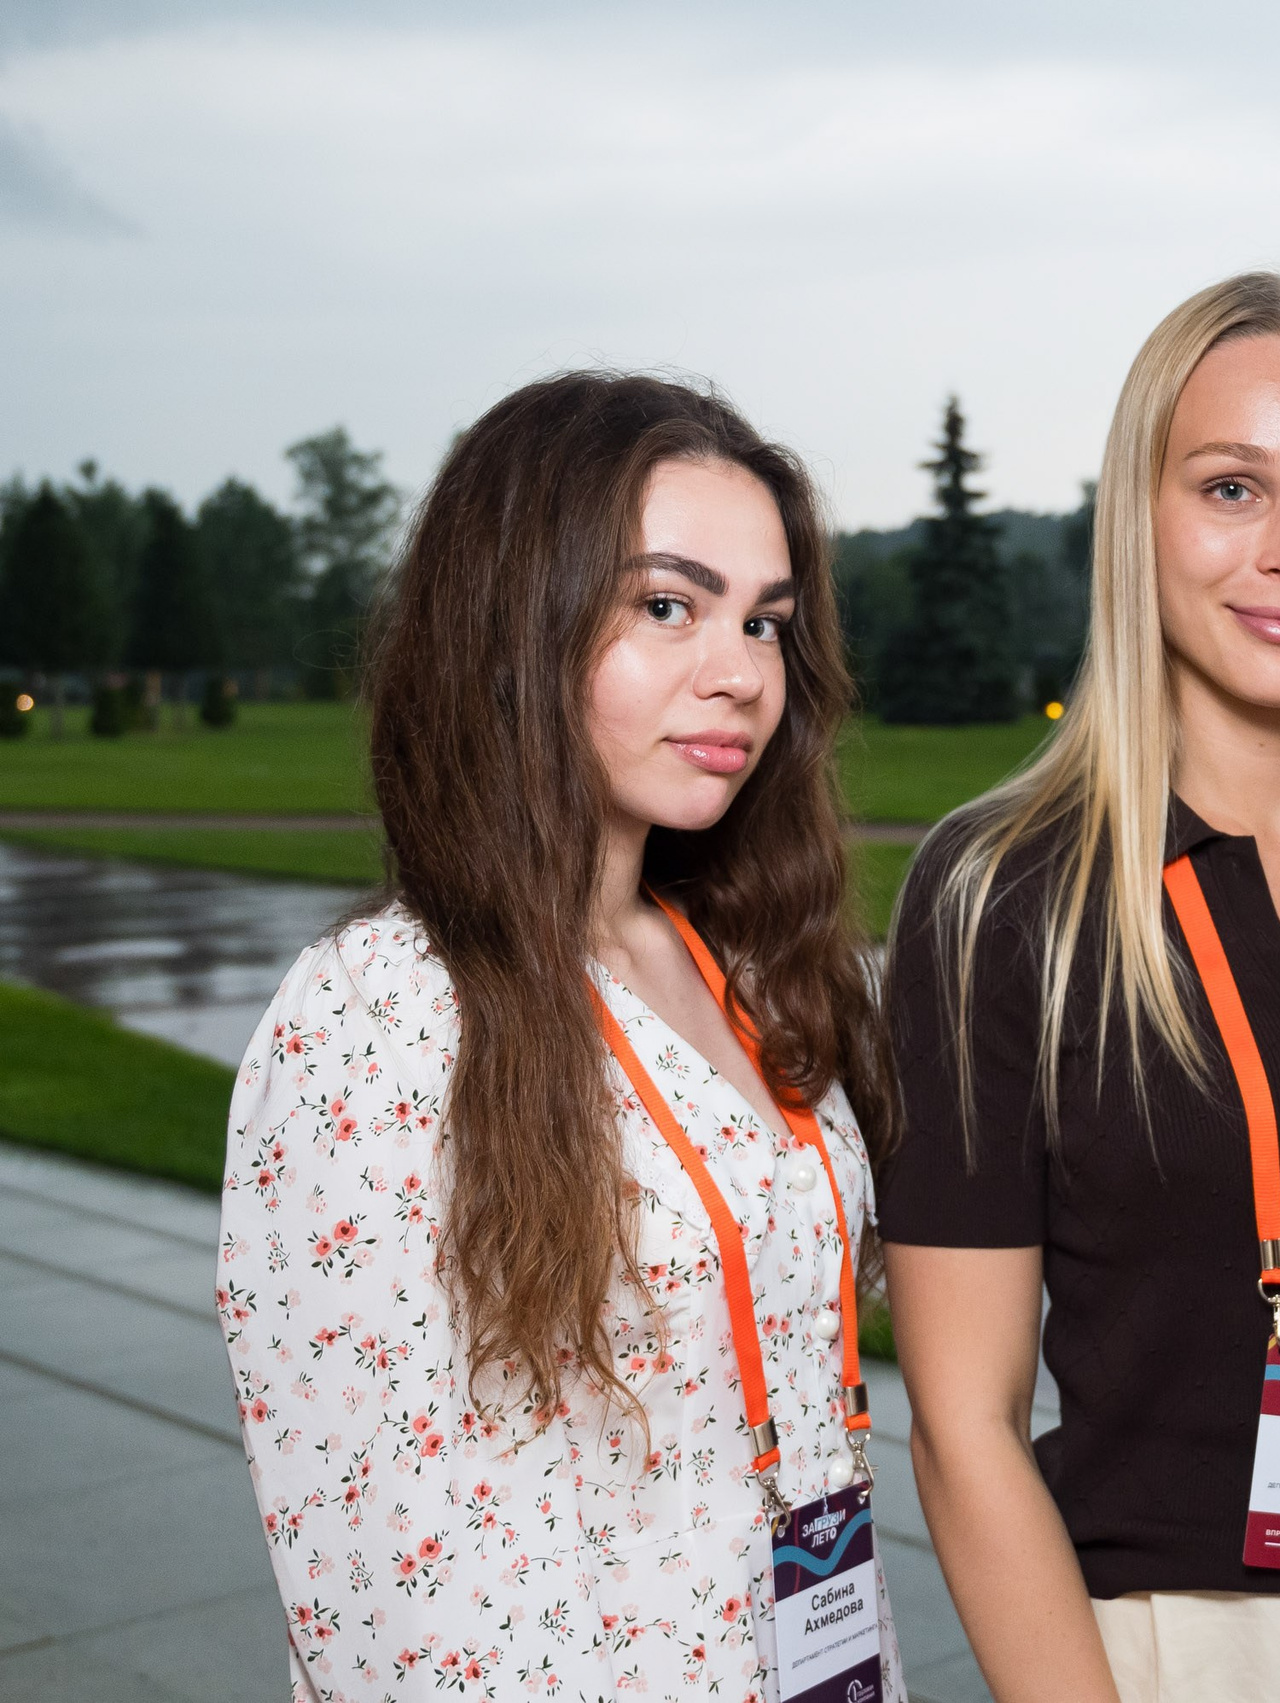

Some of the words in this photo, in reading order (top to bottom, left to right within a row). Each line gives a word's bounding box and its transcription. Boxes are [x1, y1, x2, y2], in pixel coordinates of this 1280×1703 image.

[802, 1508, 846, 1538] ЗАГРУЗИ
[811, 1527, 837, 1548] ЛЕТО
[811, 1582, 855, 1611] Сабина
[804, 1598, 864, 1635] Ахмедова
